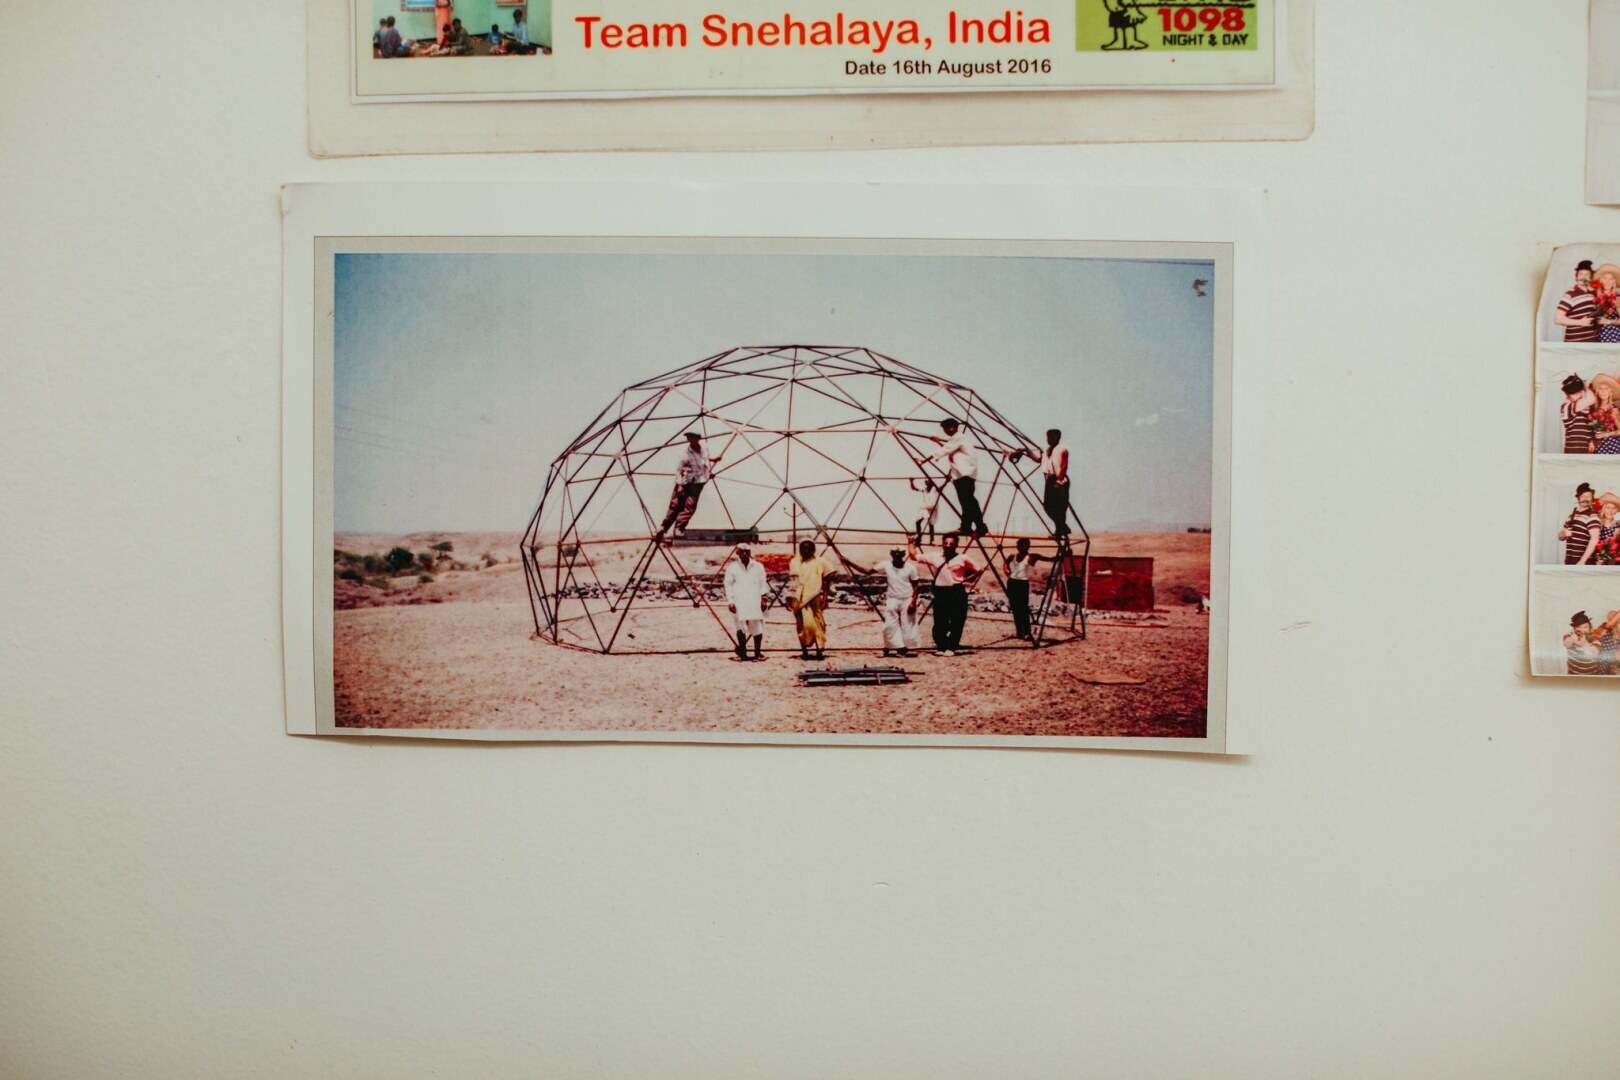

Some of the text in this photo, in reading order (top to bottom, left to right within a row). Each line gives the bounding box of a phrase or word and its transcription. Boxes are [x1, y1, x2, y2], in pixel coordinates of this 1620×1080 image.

[1157, 6, 1246, 32] 1098
[575, 10, 1051, 54] Team Snehalaya, India
[1162, 33, 1249, 47] NIGHT & DAY
[845, 58, 1052, 78] Date 16th August 2016
